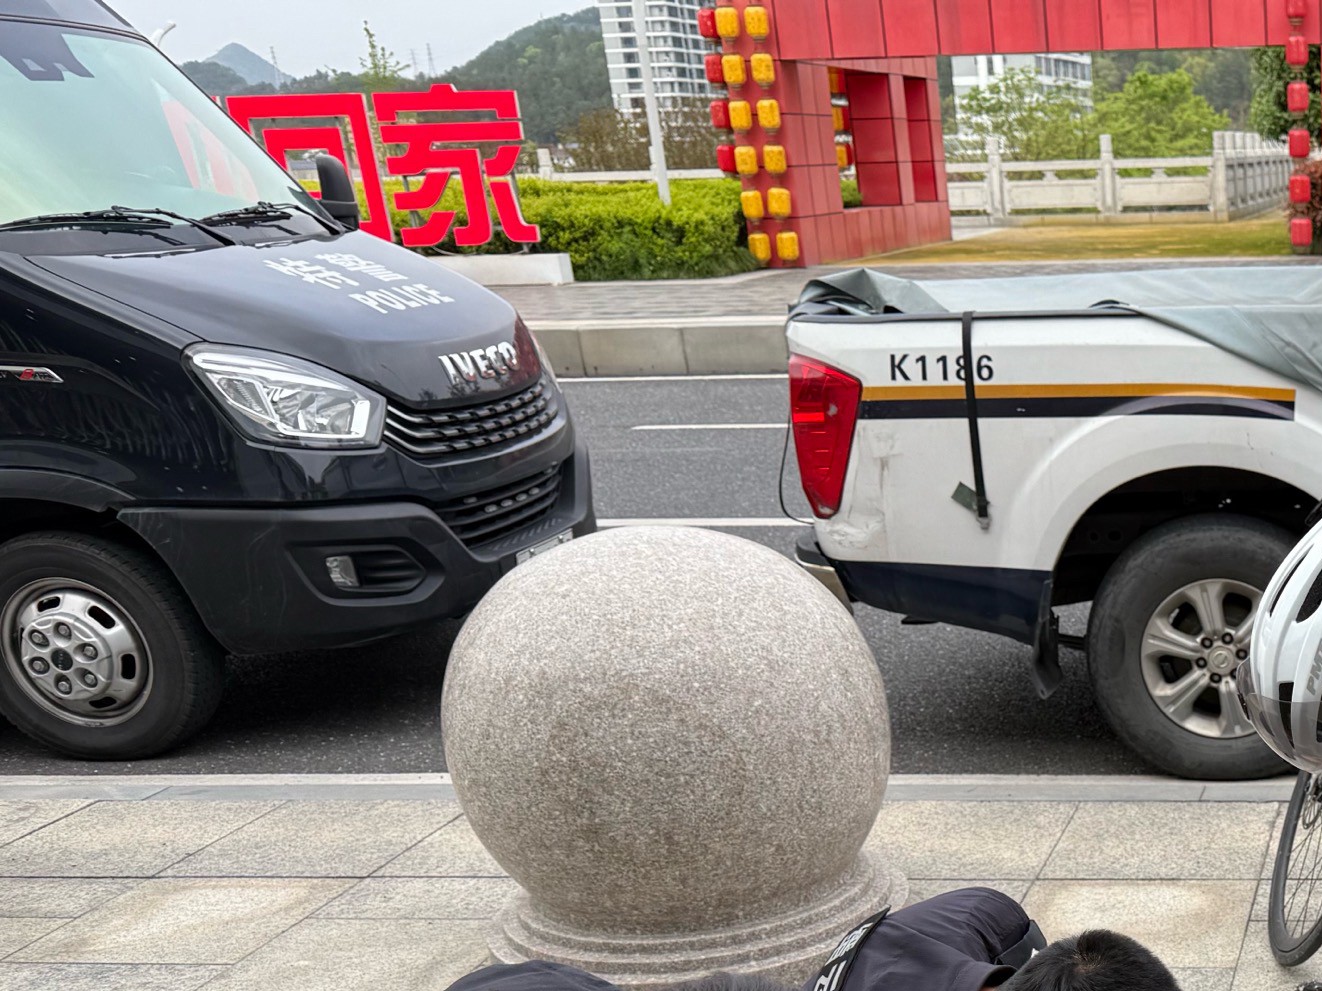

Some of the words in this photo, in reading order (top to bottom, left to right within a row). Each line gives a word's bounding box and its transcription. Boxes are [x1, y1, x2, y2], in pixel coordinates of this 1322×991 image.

[263, 252, 408, 290] 特警
[349, 283, 455, 314] POLICE
[438, 341, 521, 384] IVECO
